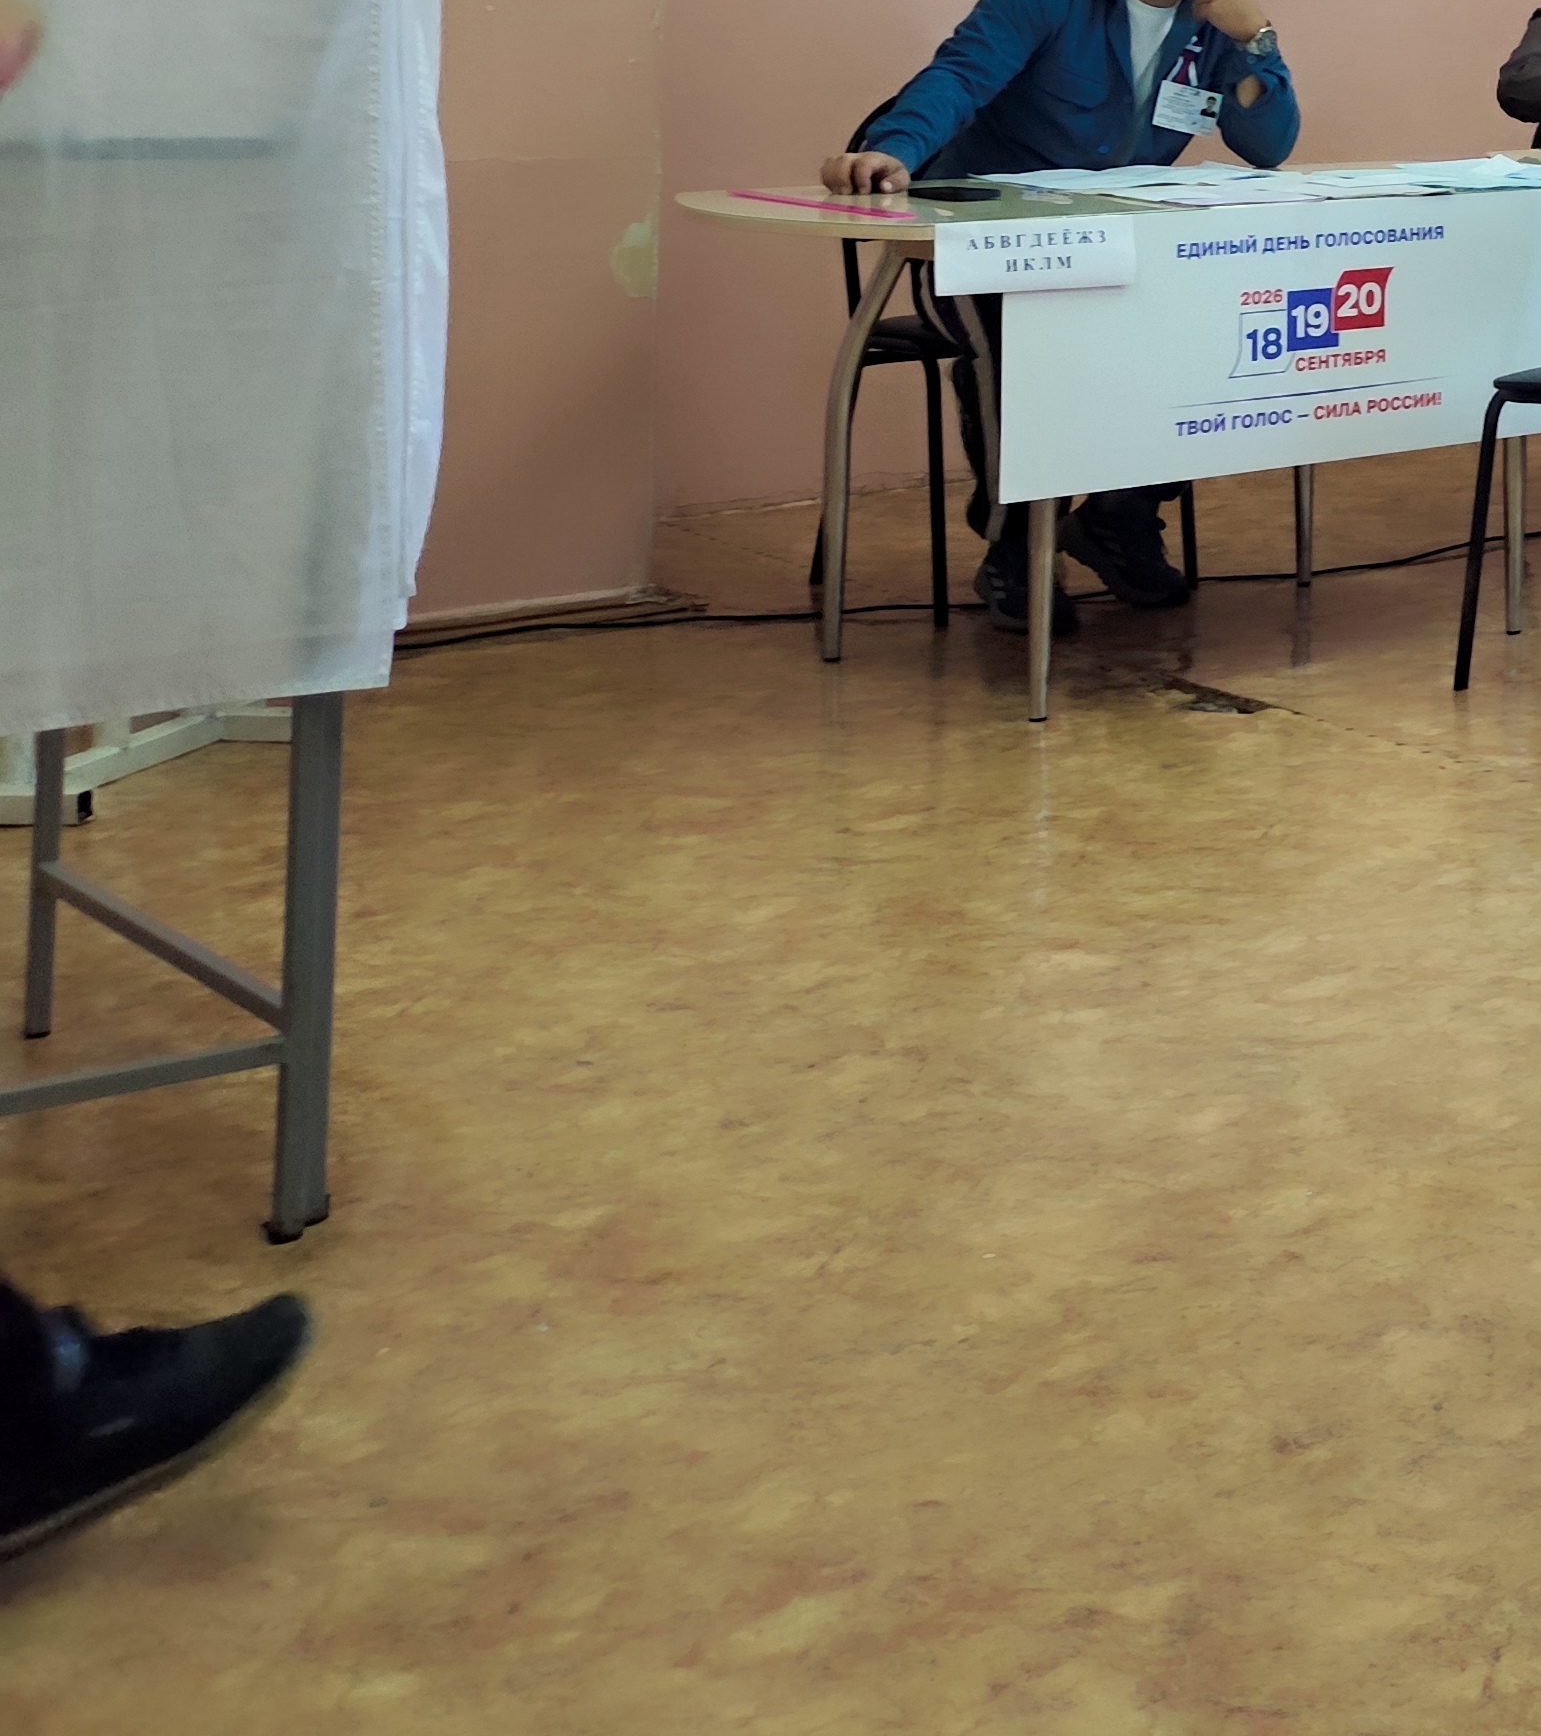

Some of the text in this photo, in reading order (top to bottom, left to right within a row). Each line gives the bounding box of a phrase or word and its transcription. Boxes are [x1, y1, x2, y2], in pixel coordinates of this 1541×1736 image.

[1176, 226, 1445, 259] ЕДИНЫЙ ДЕНЬ ГОЛОСОВАНИЯ
[1240, 289, 1284, 306] 2026
[1245, 282, 1383, 362] 18 19 20
[1295, 349, 1387, 372] СЕНТЯБРЯ
[1175, 414, 1226, 437] ТВОЙ
[1231, 409, 1293, 431] ГОЛОС
[1313, 401, 1362, 421] СИЛА
[1366, 391, 1442, 413] РОССИИ!
